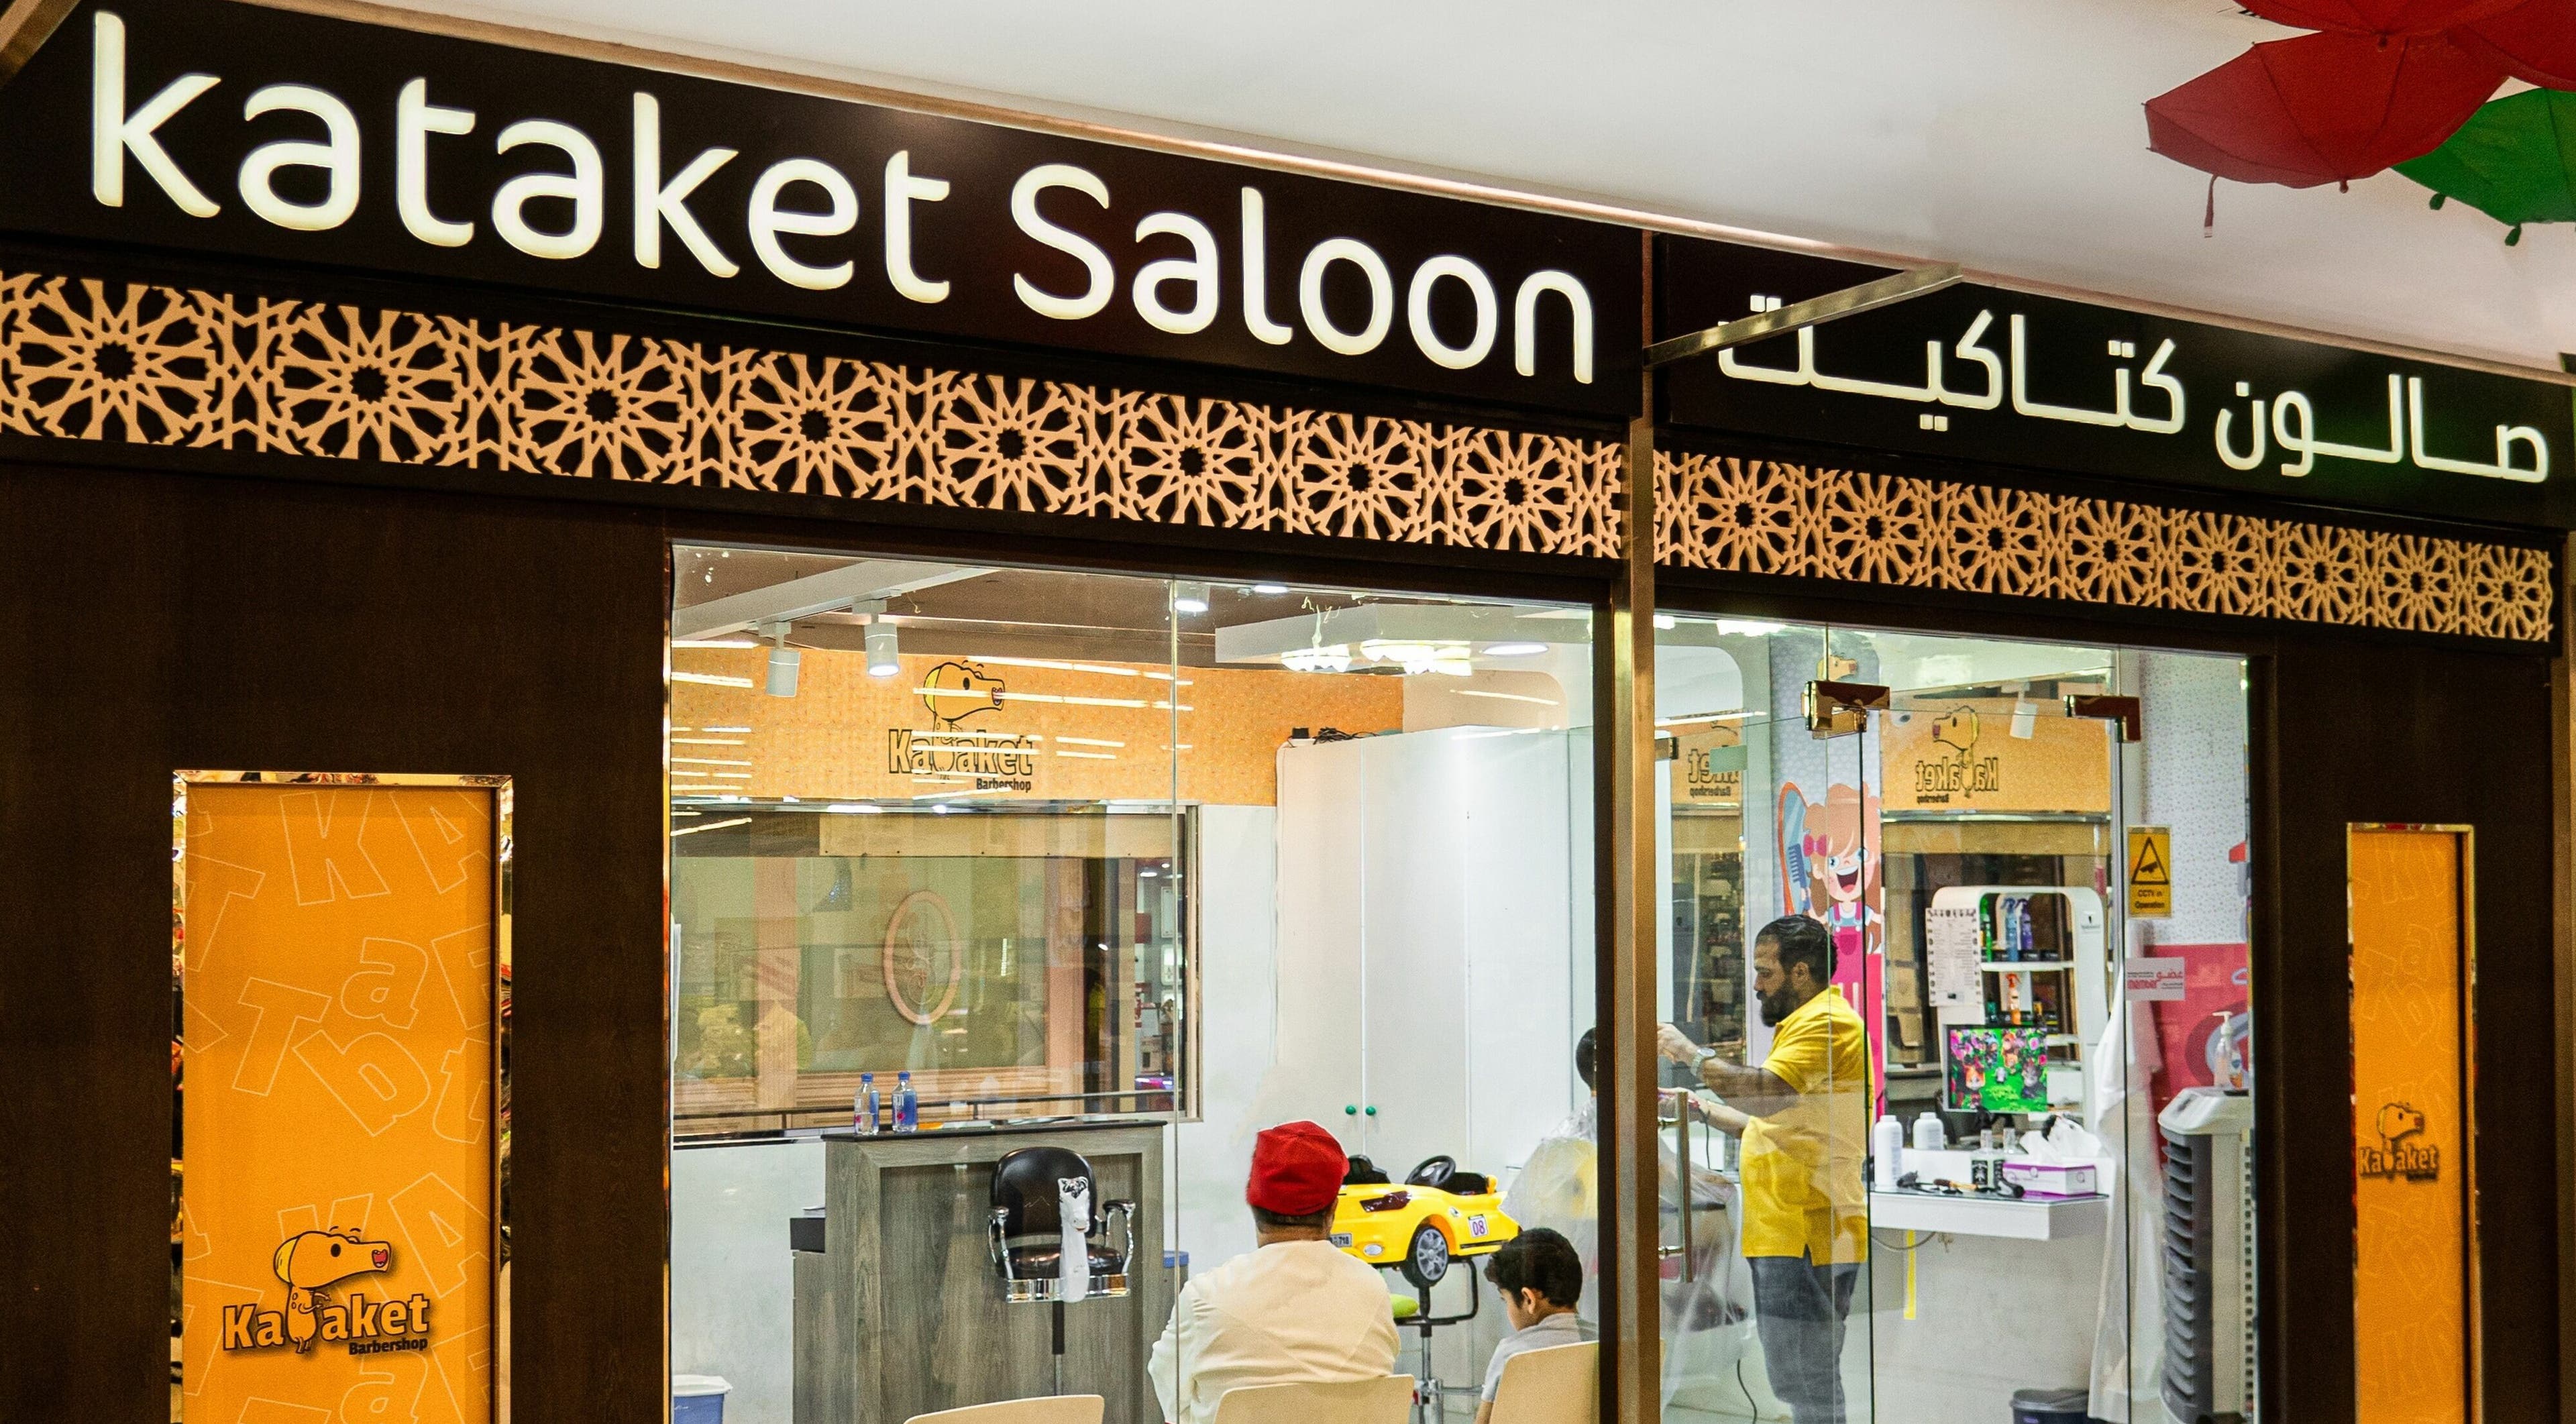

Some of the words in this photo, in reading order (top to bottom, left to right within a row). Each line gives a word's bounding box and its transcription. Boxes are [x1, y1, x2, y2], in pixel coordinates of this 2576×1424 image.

[93, 11, 950, 304] kataket
[1011, 164, 1593, 385] Saloon
[1718, 294, 2185, 434] كتاكيت
[2215, 374, 2549, 484] صالون
[977, 778, 1031, 793] Barbershop
[1472, 1220, 1485, 1236] 08
[223, 1293, 430, 1351] Kaaket
[349, 1337, 428, 1356] Barbershop
